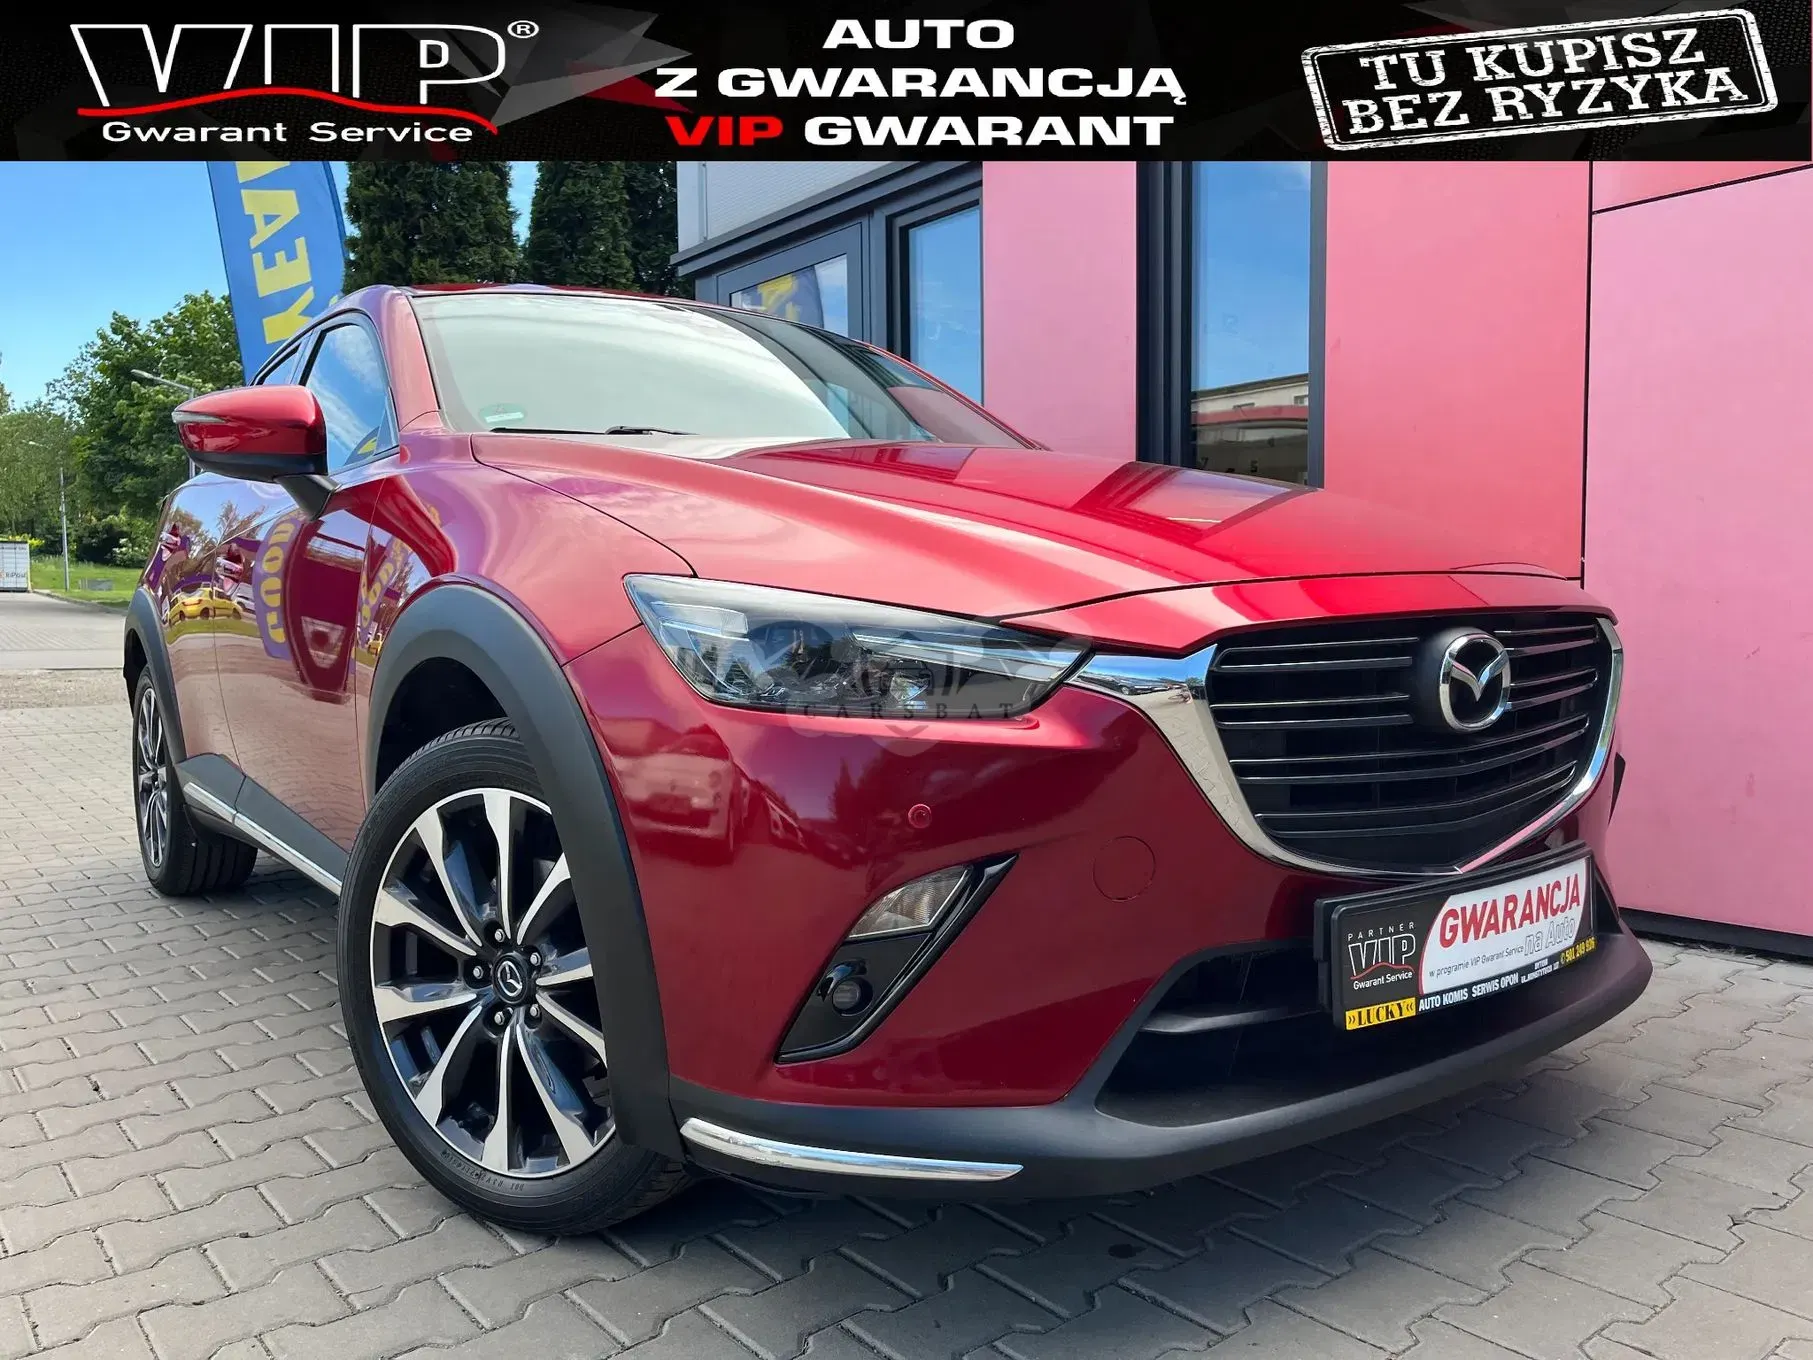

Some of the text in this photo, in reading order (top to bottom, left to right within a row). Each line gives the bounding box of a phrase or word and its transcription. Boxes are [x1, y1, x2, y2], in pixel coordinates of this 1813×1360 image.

[1440, 873, 1580, 948] GWARANCJA
[1347, 921, 1415, 941] PARTNER
[1524, 917, 1576, 956] na Auto
[1348, 933, 1416, 976] VIP
[1436, 960, 1470, 979] programie
[1470, 955, 1481, 967] VIP
[1481, 950, 1504, 964] Gwarant
[1505, 945, 1524, 957] Service
[1353, 970, 1413, 990] Gwarant Service
[1419, 995, 1441, 1012] AUTO
[1442, 991, 1468, 1006] KOMIS
[1472, 979, 1499, 998] SERWIS
[1500, 973, 1519, 989] OPON
